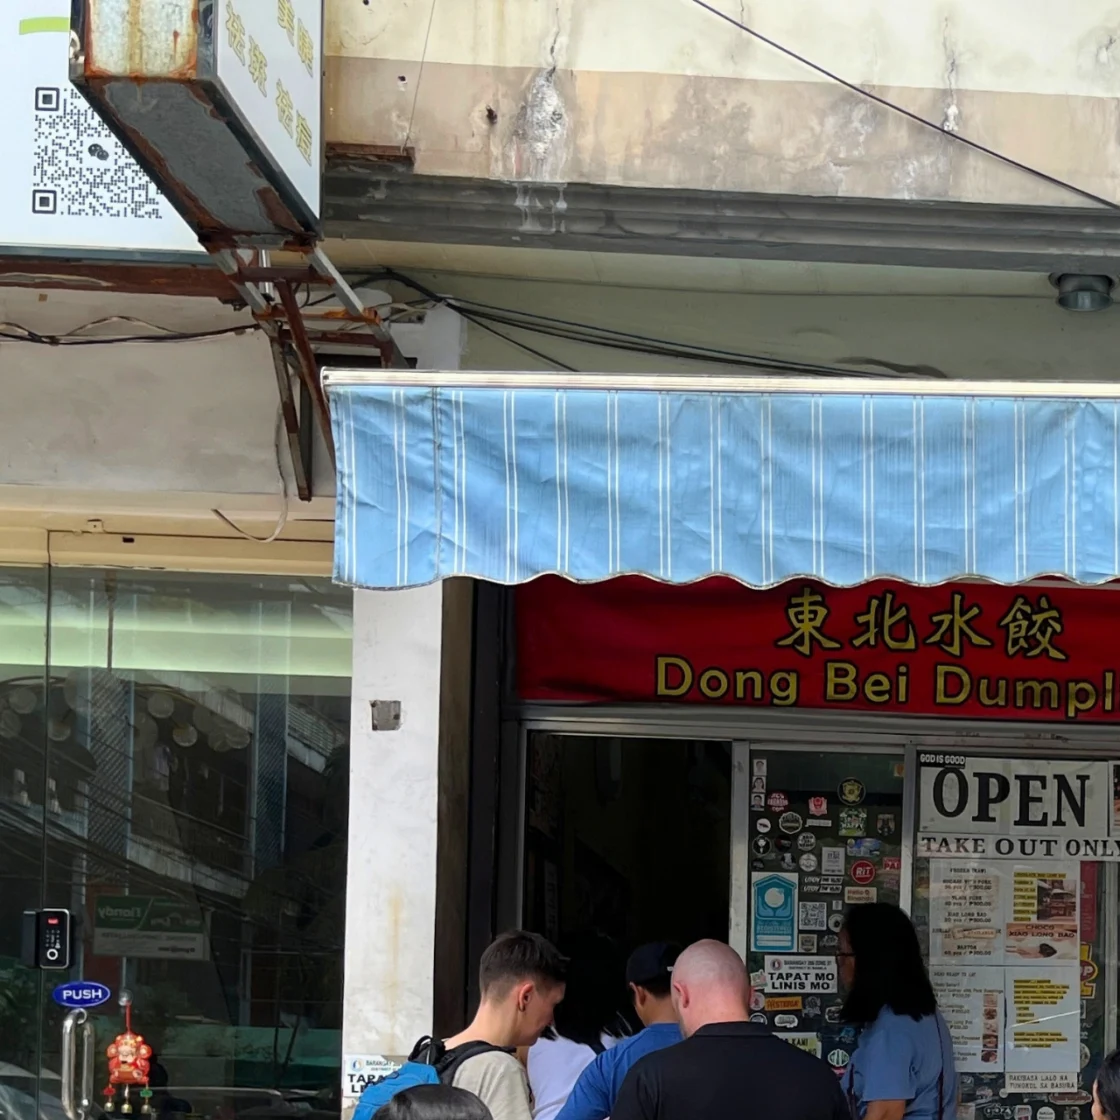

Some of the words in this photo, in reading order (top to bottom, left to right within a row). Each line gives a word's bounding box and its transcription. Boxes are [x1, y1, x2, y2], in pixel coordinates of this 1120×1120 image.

[776, 585, 1068, 662] 東北水餃
[654, 654, 799, 708] Dong
[824, 657, 909, 704] Bei
[920, 754, 935, 764] GOD
[936, 755, 944, 764] IS
[945, 755, 966, 766] GOOD
[933, 767, 1090, 827] OPEN
[922, 837, 985, 855] TAKE
[995, 838, 1058, 857] OUT
[768, 973, 811, 981] TAPAT
[815, 973, 835, 981] MO
[771, 982, 806, 990] LINIS
[810, 982, 830, 990] MO
[62, 988, 103, 1001] PUSH
